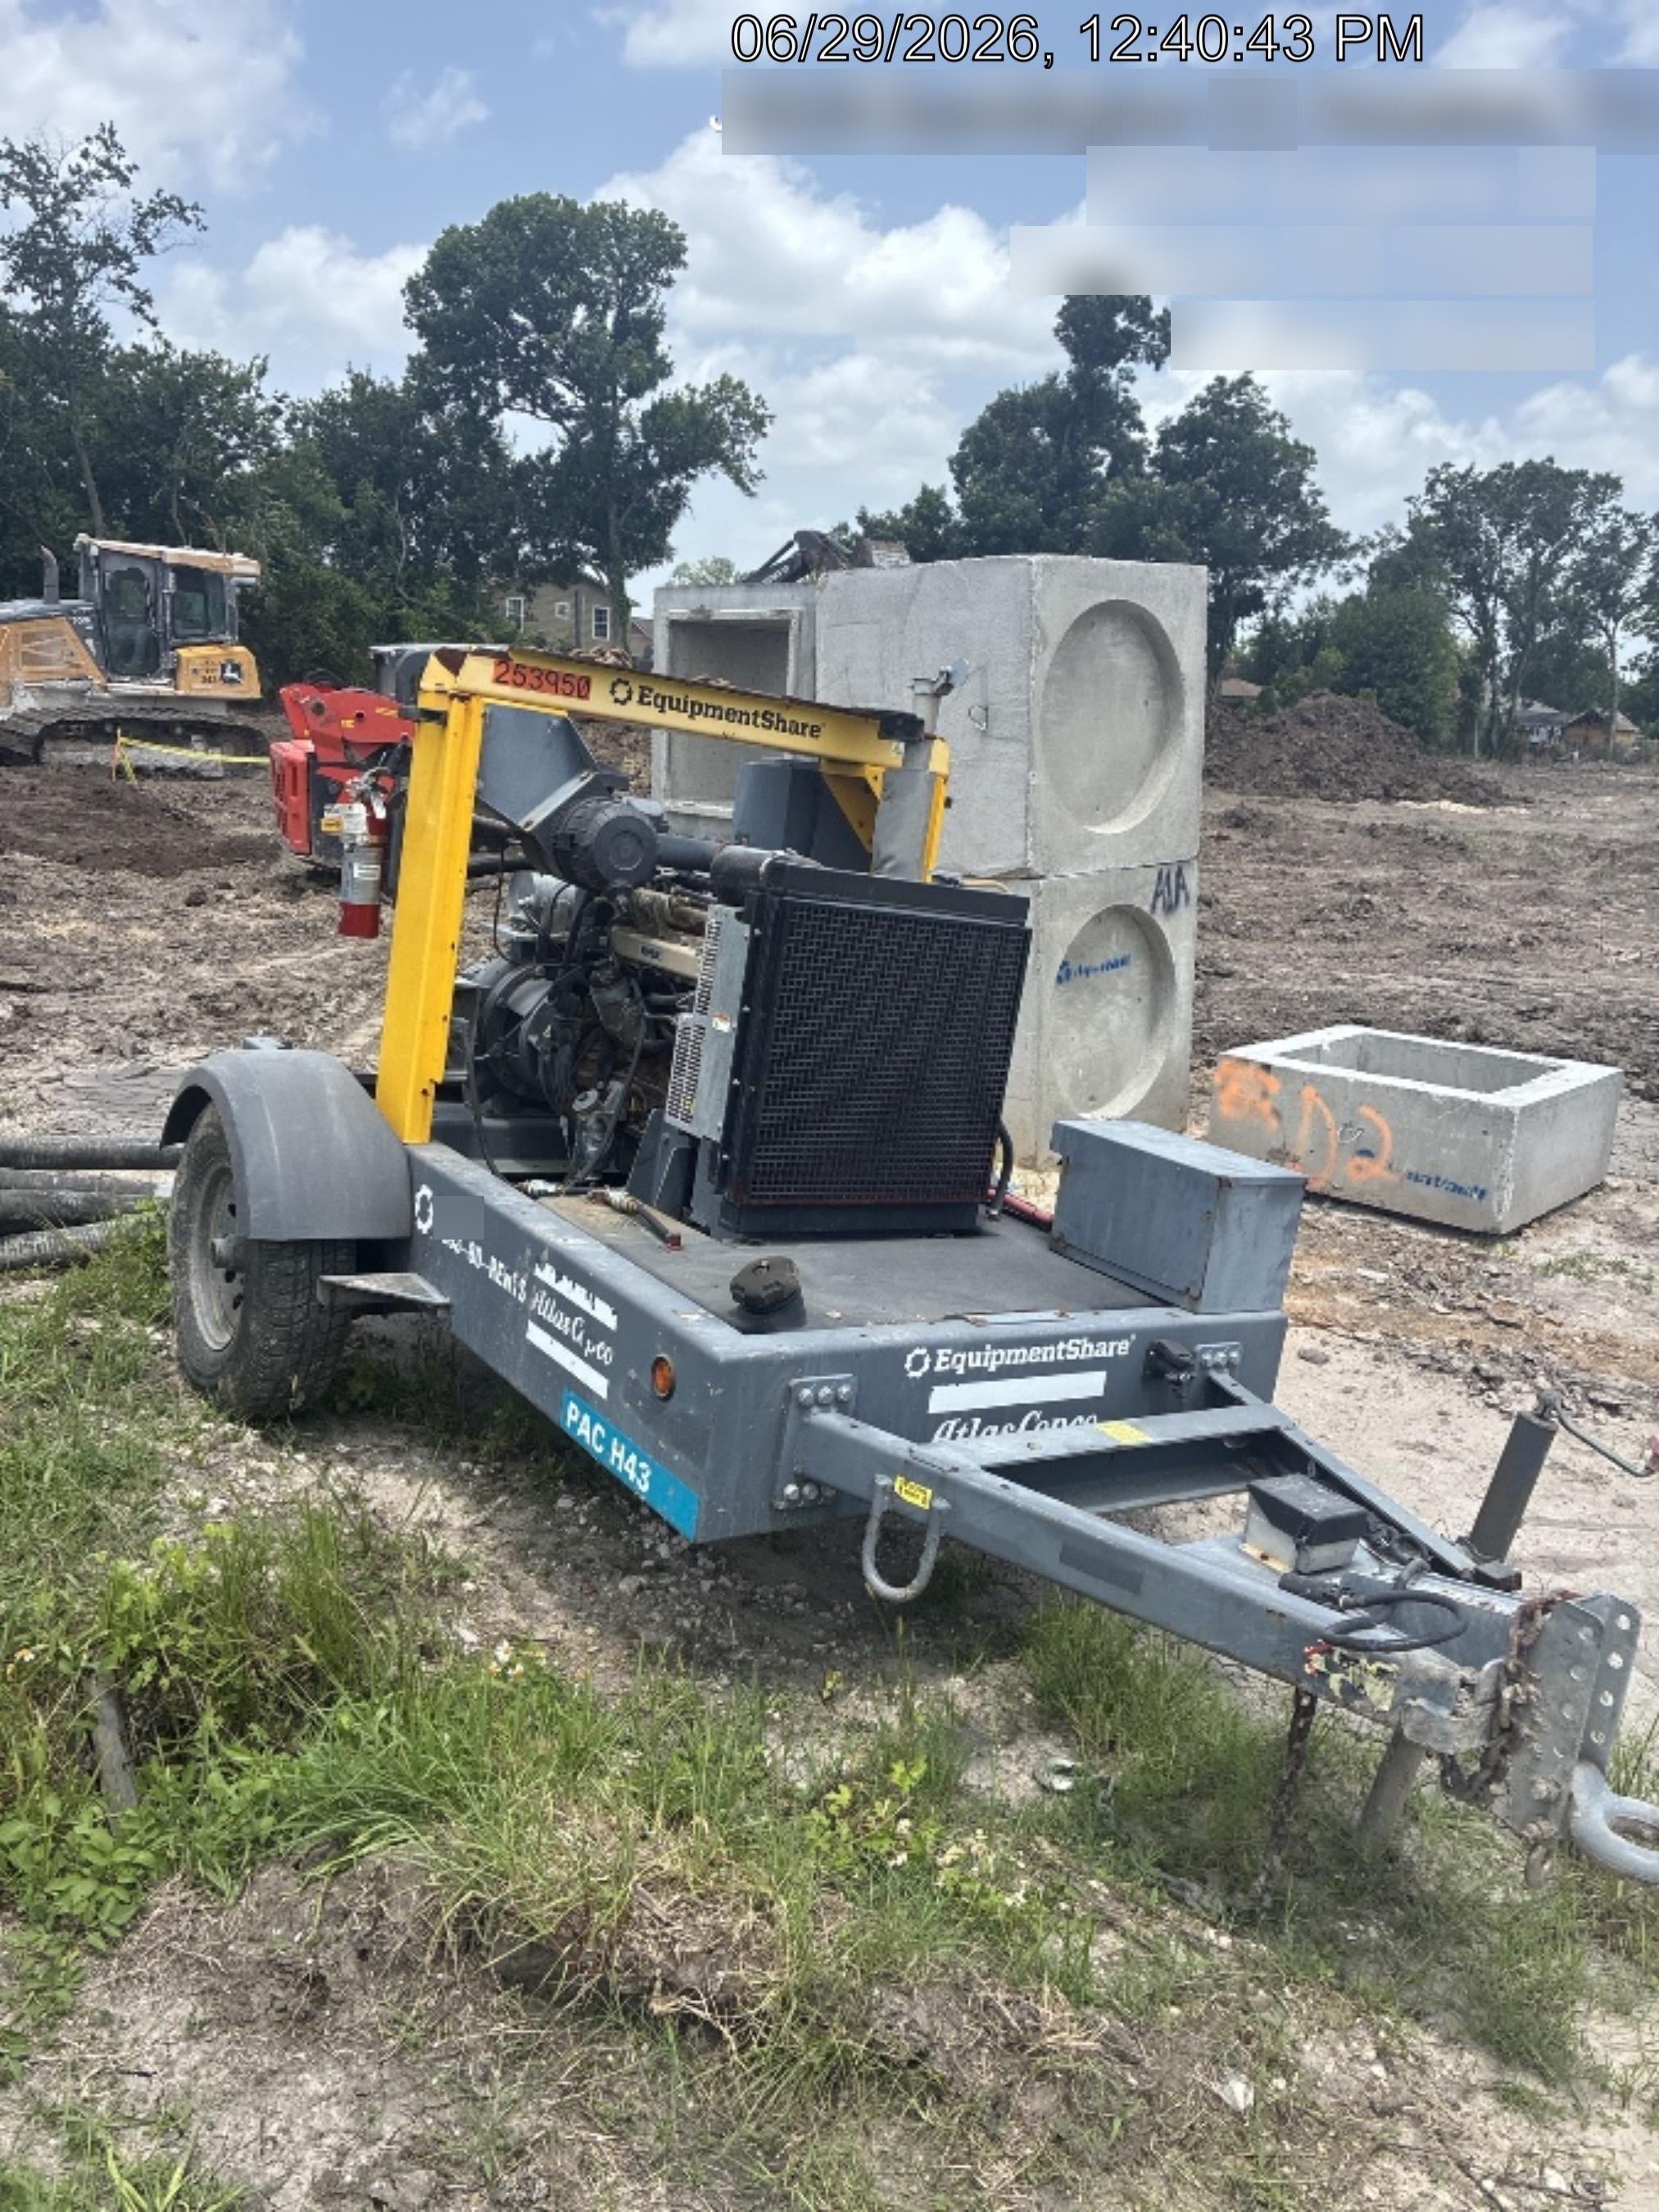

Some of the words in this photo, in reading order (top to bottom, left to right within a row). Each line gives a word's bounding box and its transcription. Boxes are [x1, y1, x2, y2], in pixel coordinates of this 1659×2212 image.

[493, 659, 591, 700] 253950
[637, 685, 823, 739] EquipmentShare
[933, 1337, 1131, 1375] EquipmentShare
[566, 1400, 605, 1453] PAC
[610, 1437, 651, 1493] H43
